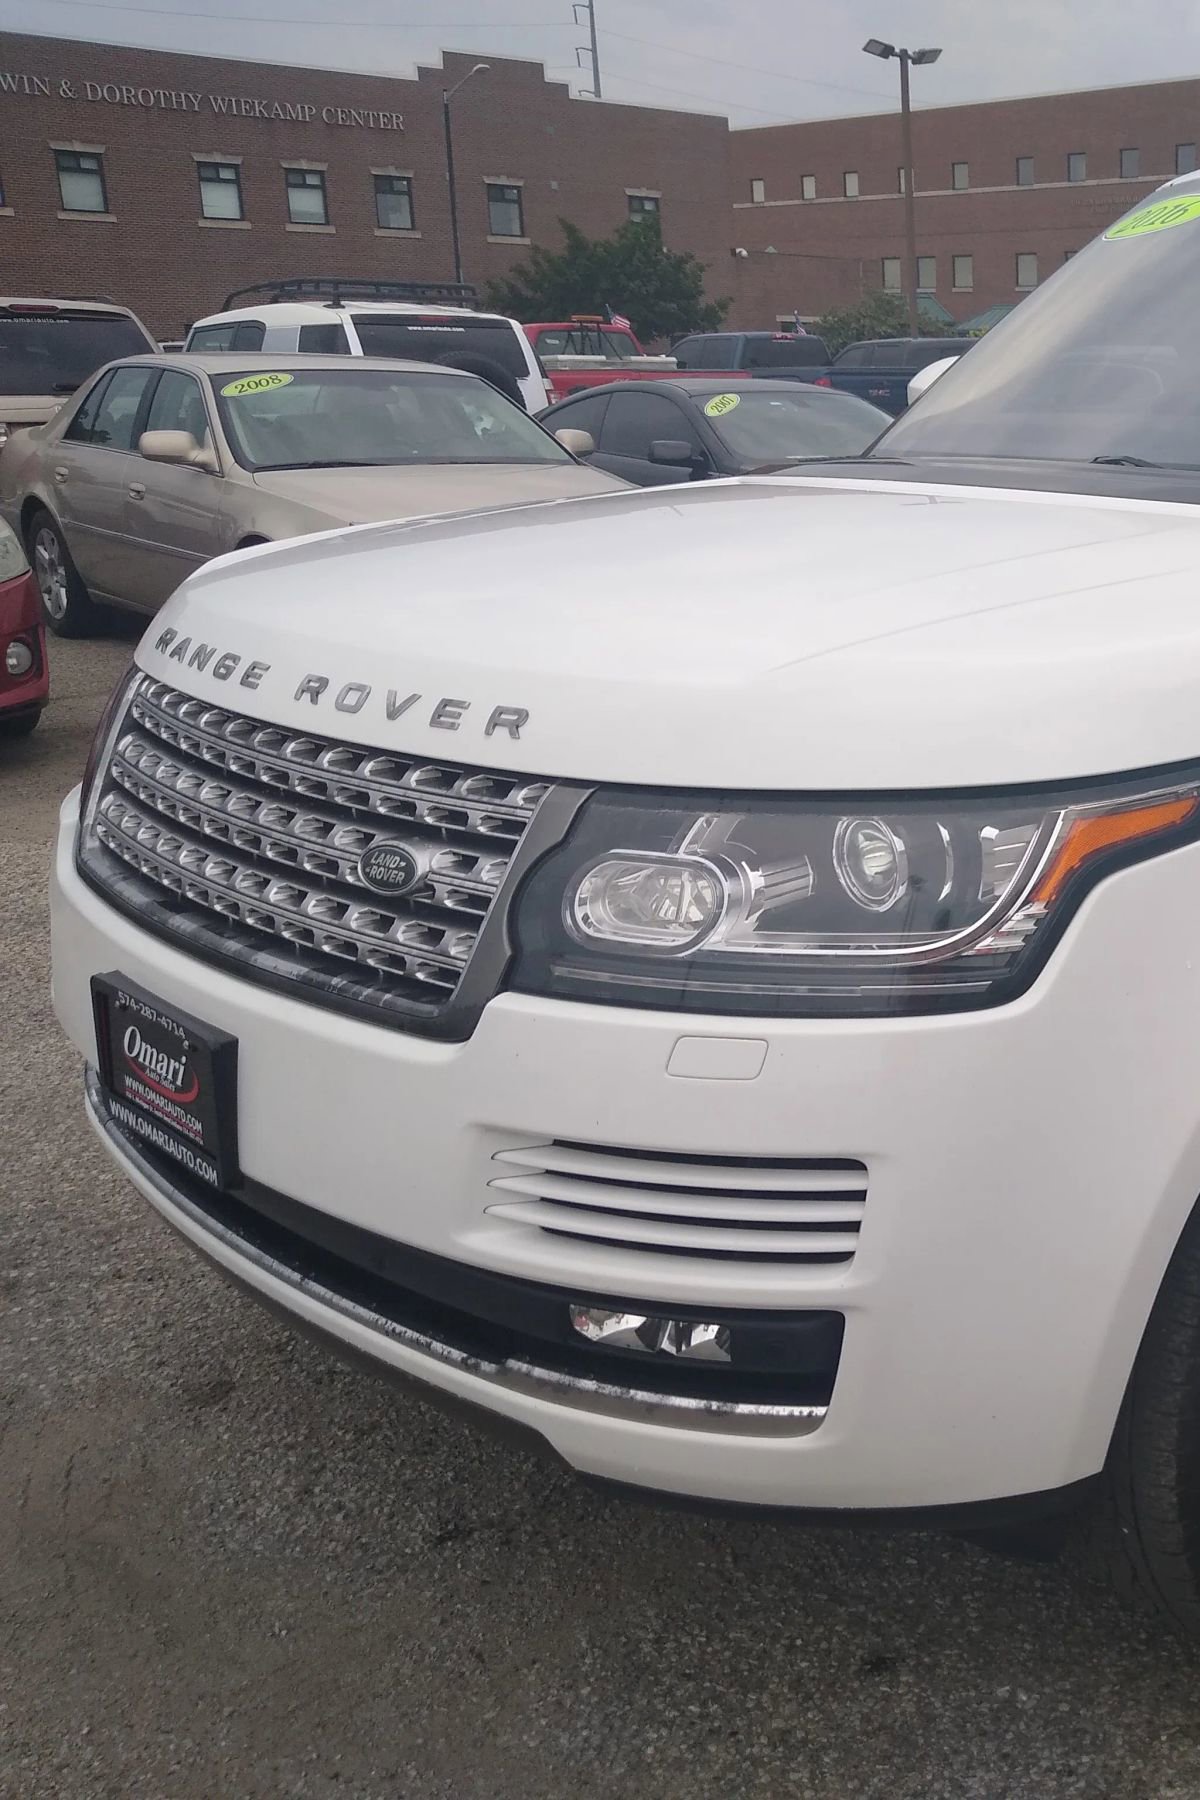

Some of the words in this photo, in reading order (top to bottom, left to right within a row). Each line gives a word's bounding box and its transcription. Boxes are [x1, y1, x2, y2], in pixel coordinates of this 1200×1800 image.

[59, 79, 77, 99] &
[84, 82, 202, 112] DOROTHY
[208, 95, 316, 122] WIEKAMP
[322, 107, 405, 131] CENTER
[234, 375, 282, 394] 2008
[154, 627, 271, 690] RANGE
[293, 673, 530, 740] ROVER
[369, 865, 405, 884] ROVER
[370, 852, 400, 868] LAND
[117, 991, 186, 1039] 574-287-4714
[123, 1026, 187, 1087] Omari
[124, 1074, 203, 1134] WWW.OMARIAUTO.COM
[109, 1098, 218, 1187] WWW.OMARIAUTO.COM
